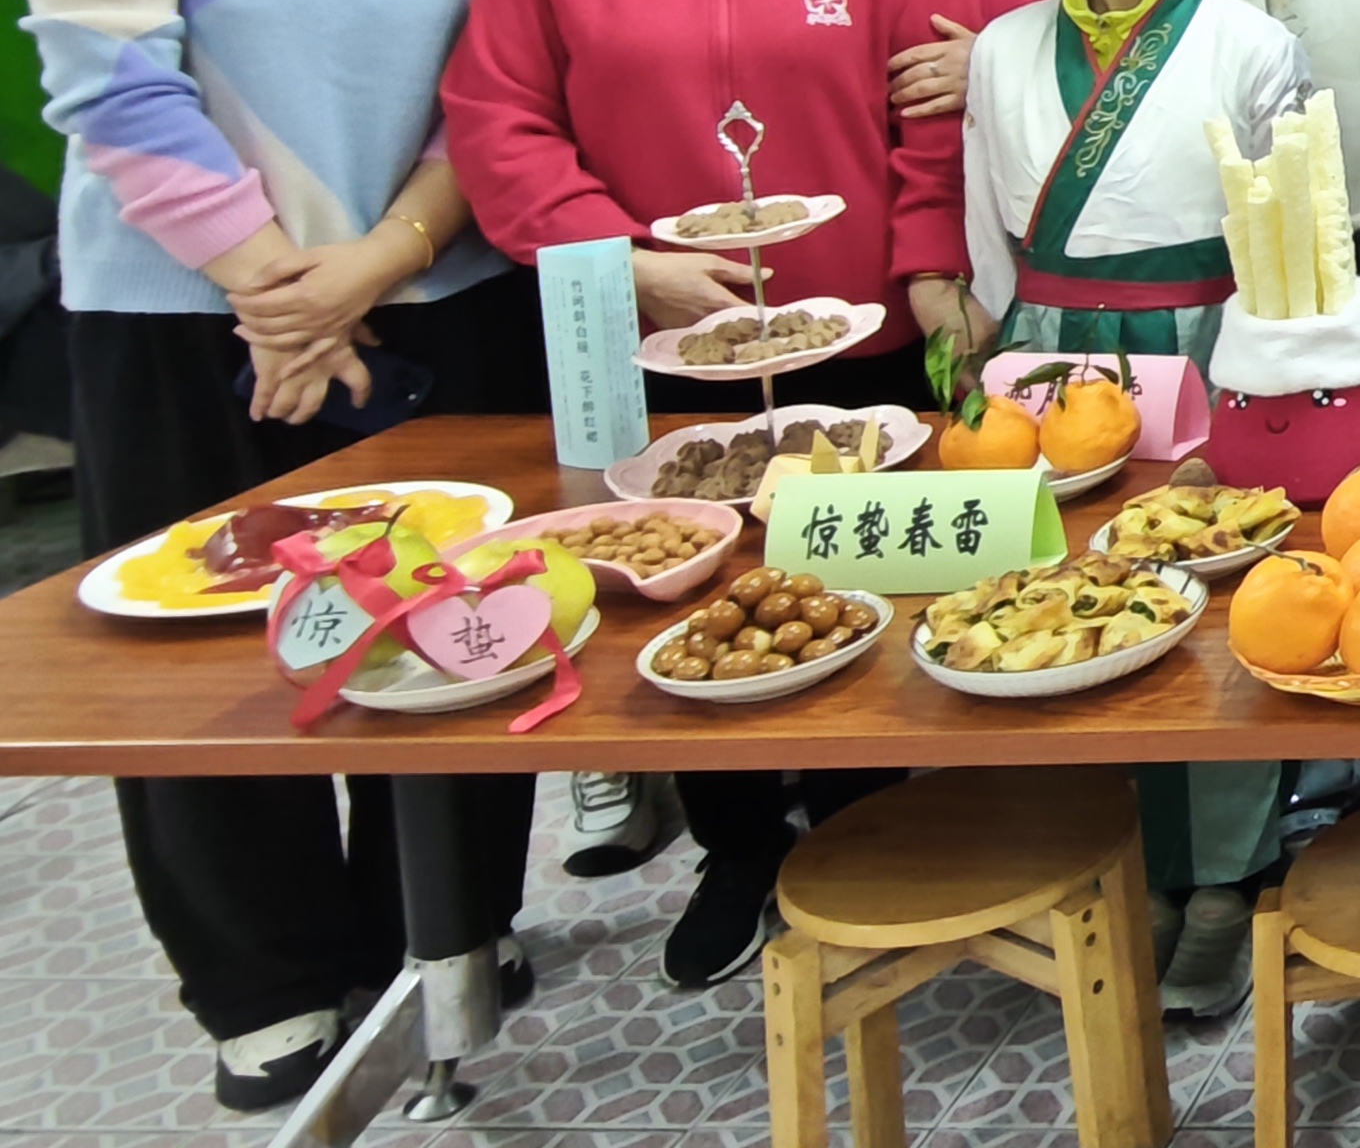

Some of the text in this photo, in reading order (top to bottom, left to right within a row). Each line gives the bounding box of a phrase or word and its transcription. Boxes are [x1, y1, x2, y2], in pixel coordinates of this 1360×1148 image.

[801, 497, 989, 561] 惊蛰春雷
[291, 599, 348, 648] 惊
[449, 615, 506, 665] 蛰
